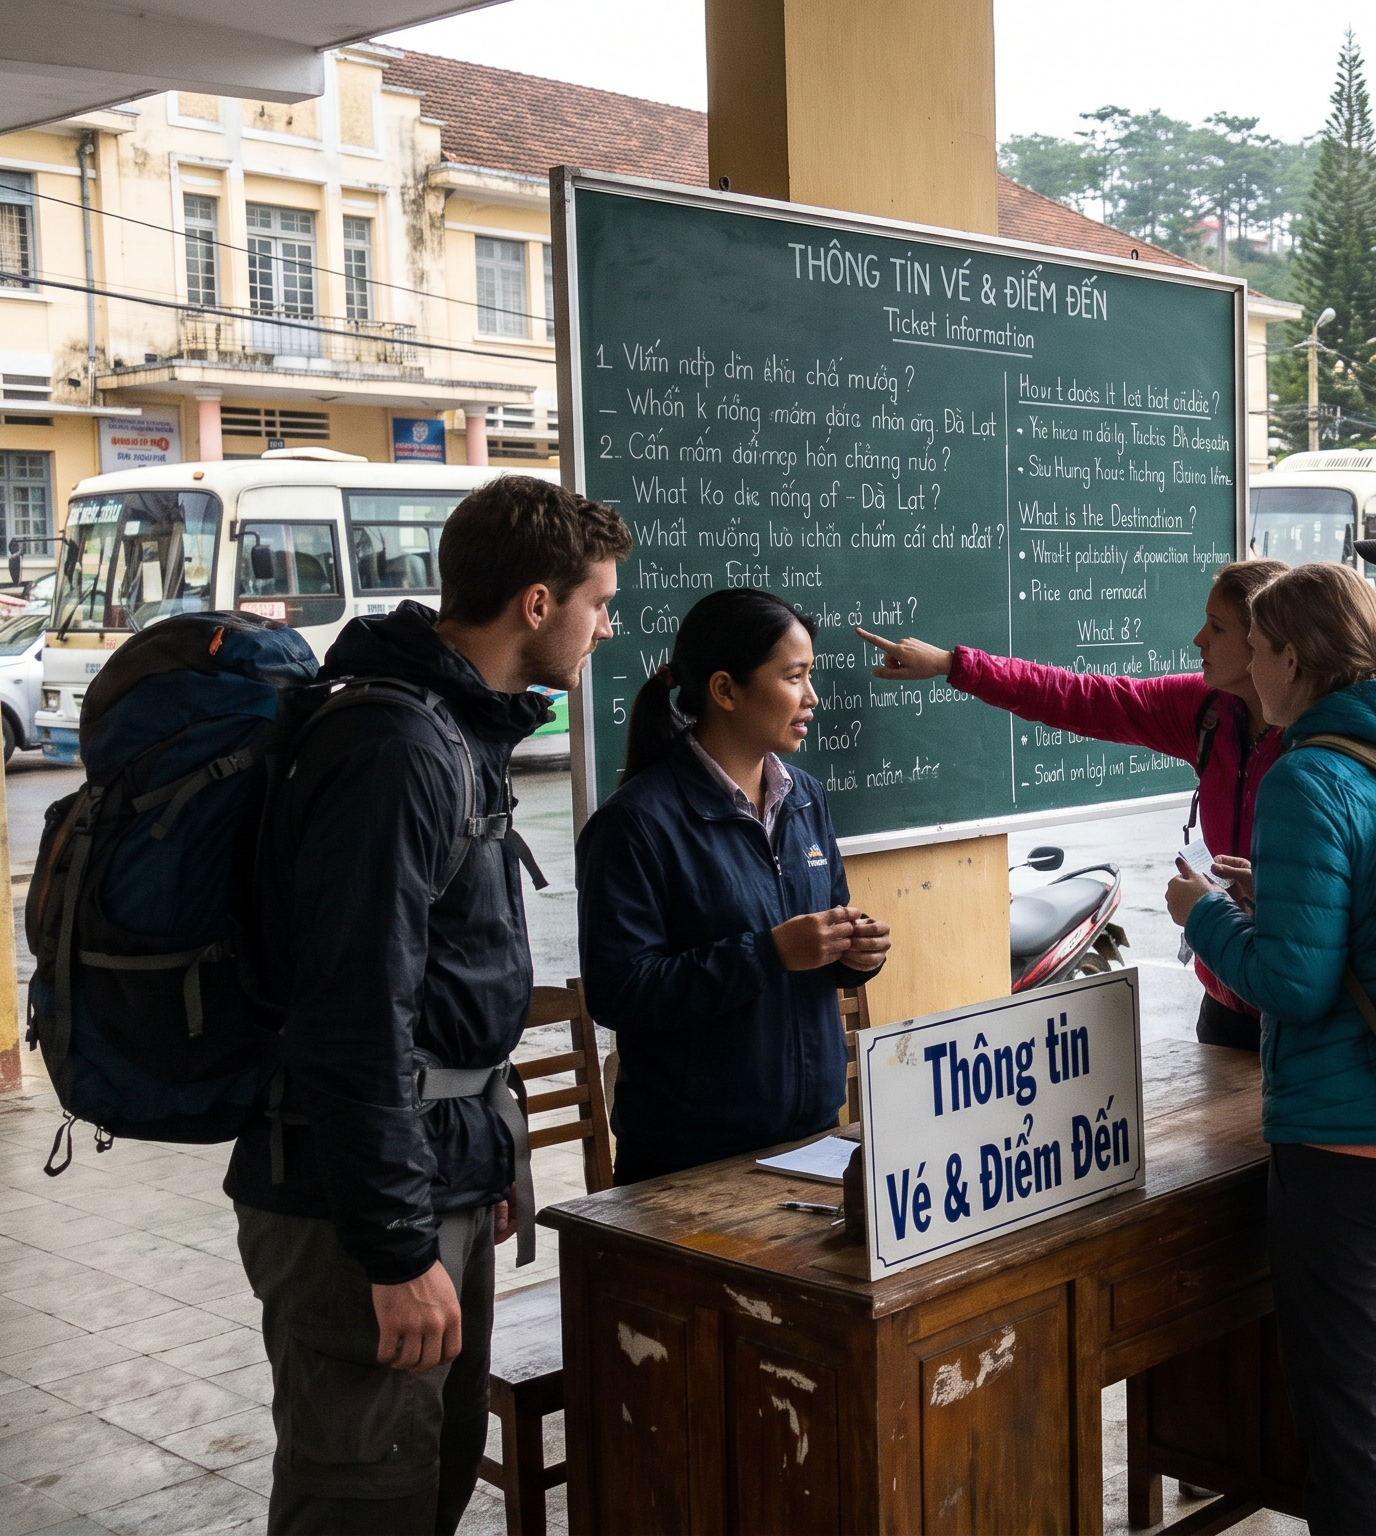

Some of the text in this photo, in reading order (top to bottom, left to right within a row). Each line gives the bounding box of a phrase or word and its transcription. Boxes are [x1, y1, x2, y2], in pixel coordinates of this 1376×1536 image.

[787, 238, 881, 289] THÔNG
[940, 257, 972, 302] VÉ
[980, 273, 997, 306] &
[1065, 274, 1108, 321] ĐẾN
[882, 306, 1035, 349] Ticket information
[905, 364, 915, 393] ?
[1211, 390, 1220, 415] ?
[942, 446, 951, 472] ?
[632, 475, 688, 504] What
[819, 480, 841, 508] of
[898, 483, 926, 516] Lạt
[931, 483, 941, 510] ?
[1018, 500, 1059, 526] What
[1064, 506, 1076, 526] is
[1081, 503, 1104, 527] the
[1189, 505, 1197, 529] ?
[996, 523, 1005, 550] ?
[1068, 577, 1093, 601] and
[907, 596, 918, 624] ?
[1077, 618, 1115, 642] What
[1133, 617, 1142, 639] ?
[923, 1011, 1090, 1117] Thông tin
[886, 1094, 1130, 1241] Vé & Điểm Đến
